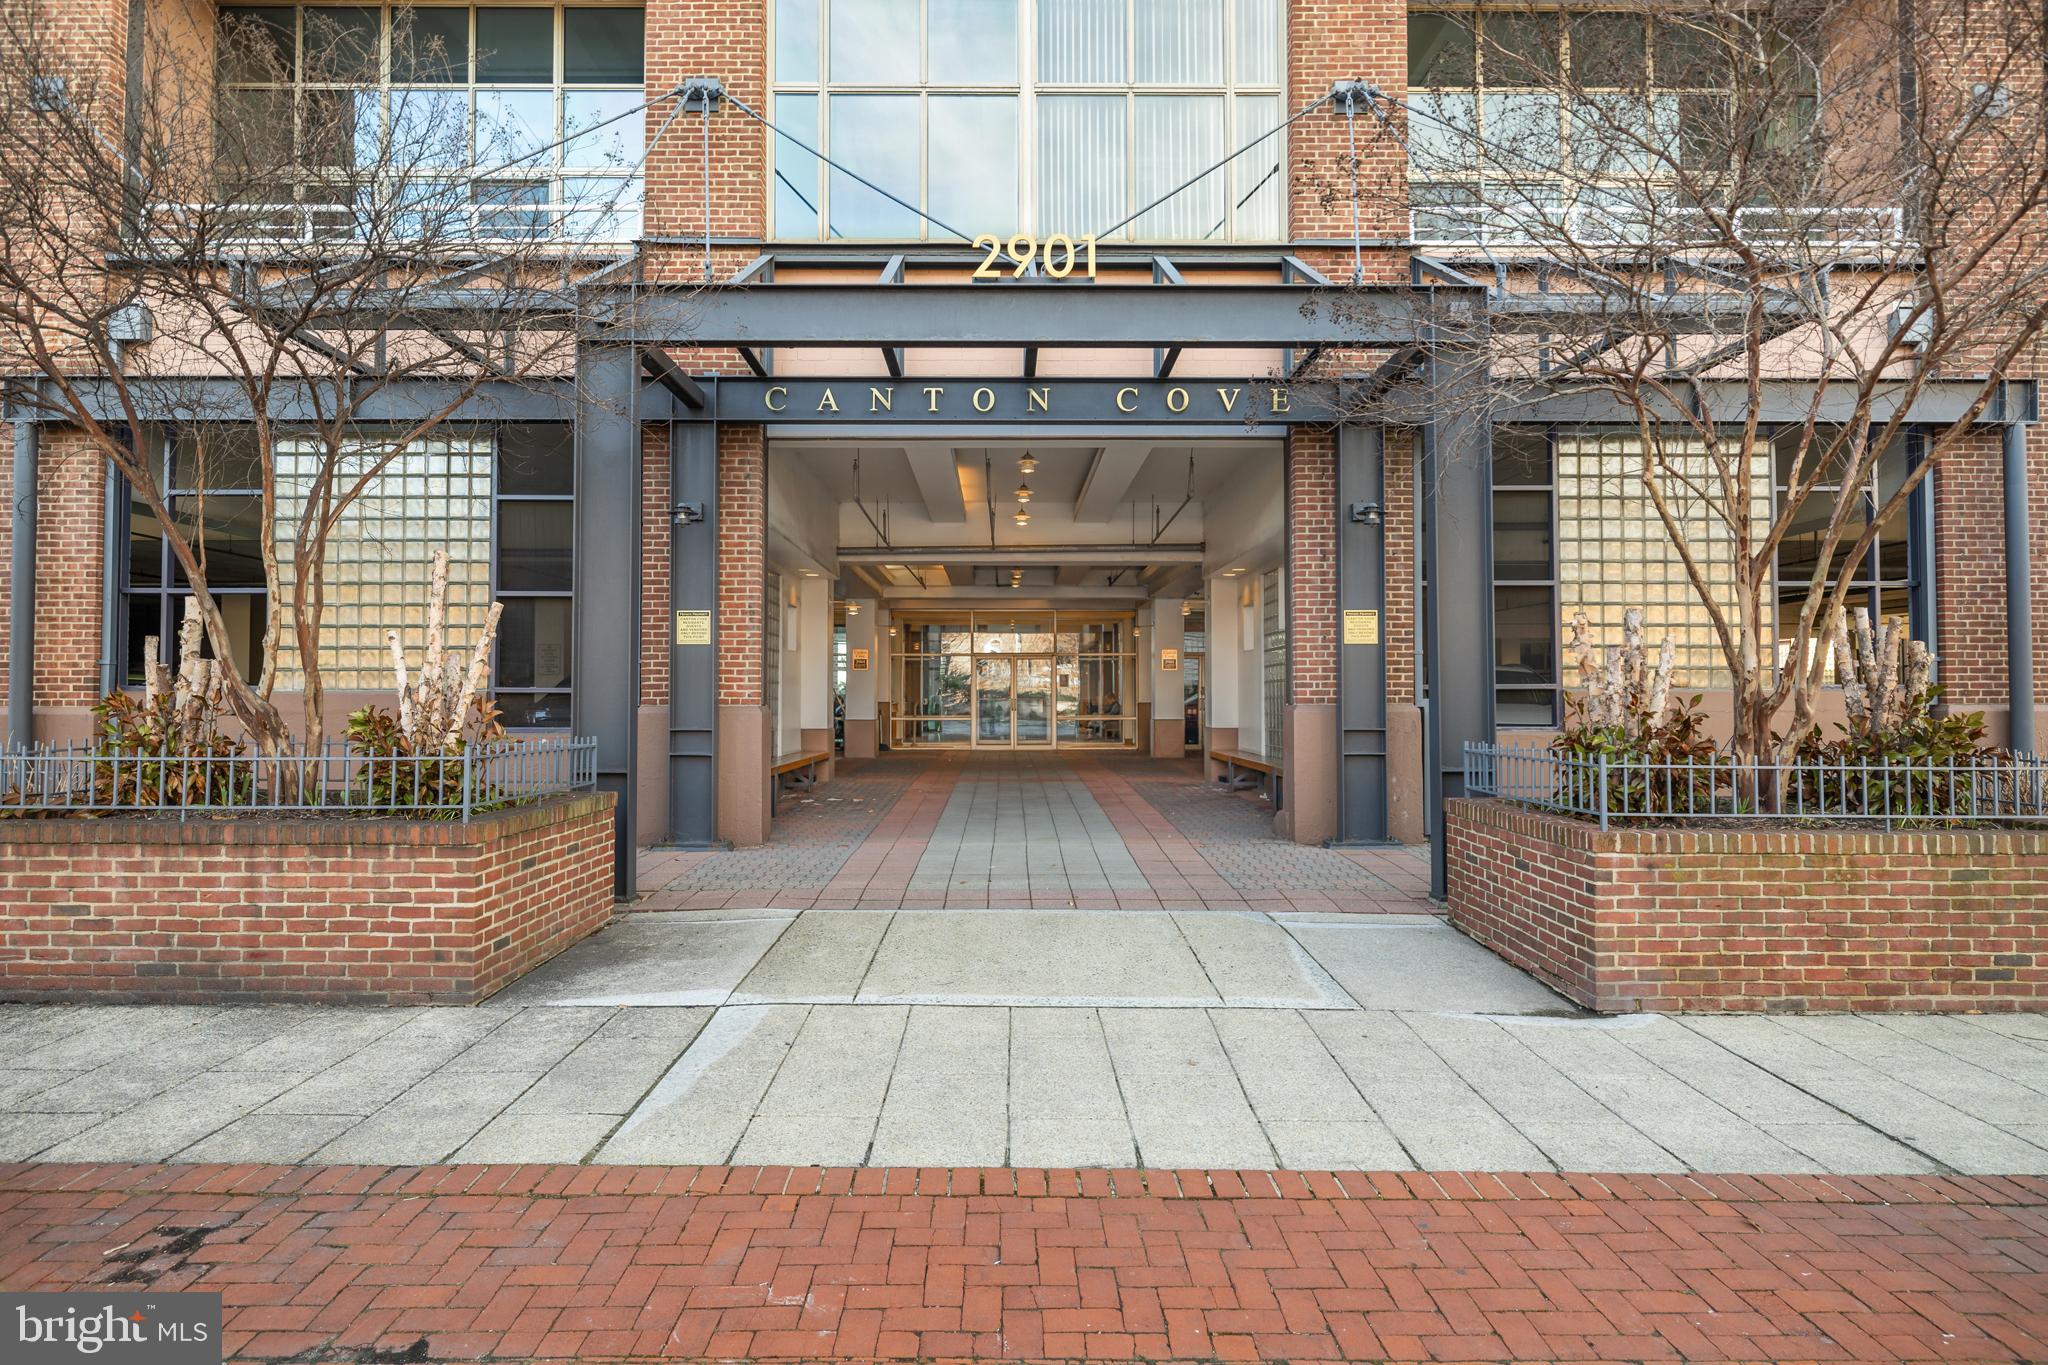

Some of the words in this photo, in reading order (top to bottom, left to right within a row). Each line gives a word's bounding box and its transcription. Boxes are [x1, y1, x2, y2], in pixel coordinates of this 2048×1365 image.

[972, 233, 1097, 279] 2901
[764, 386, 1051, 412] CANTON
[1115, 387, 1291, 412] COVE
